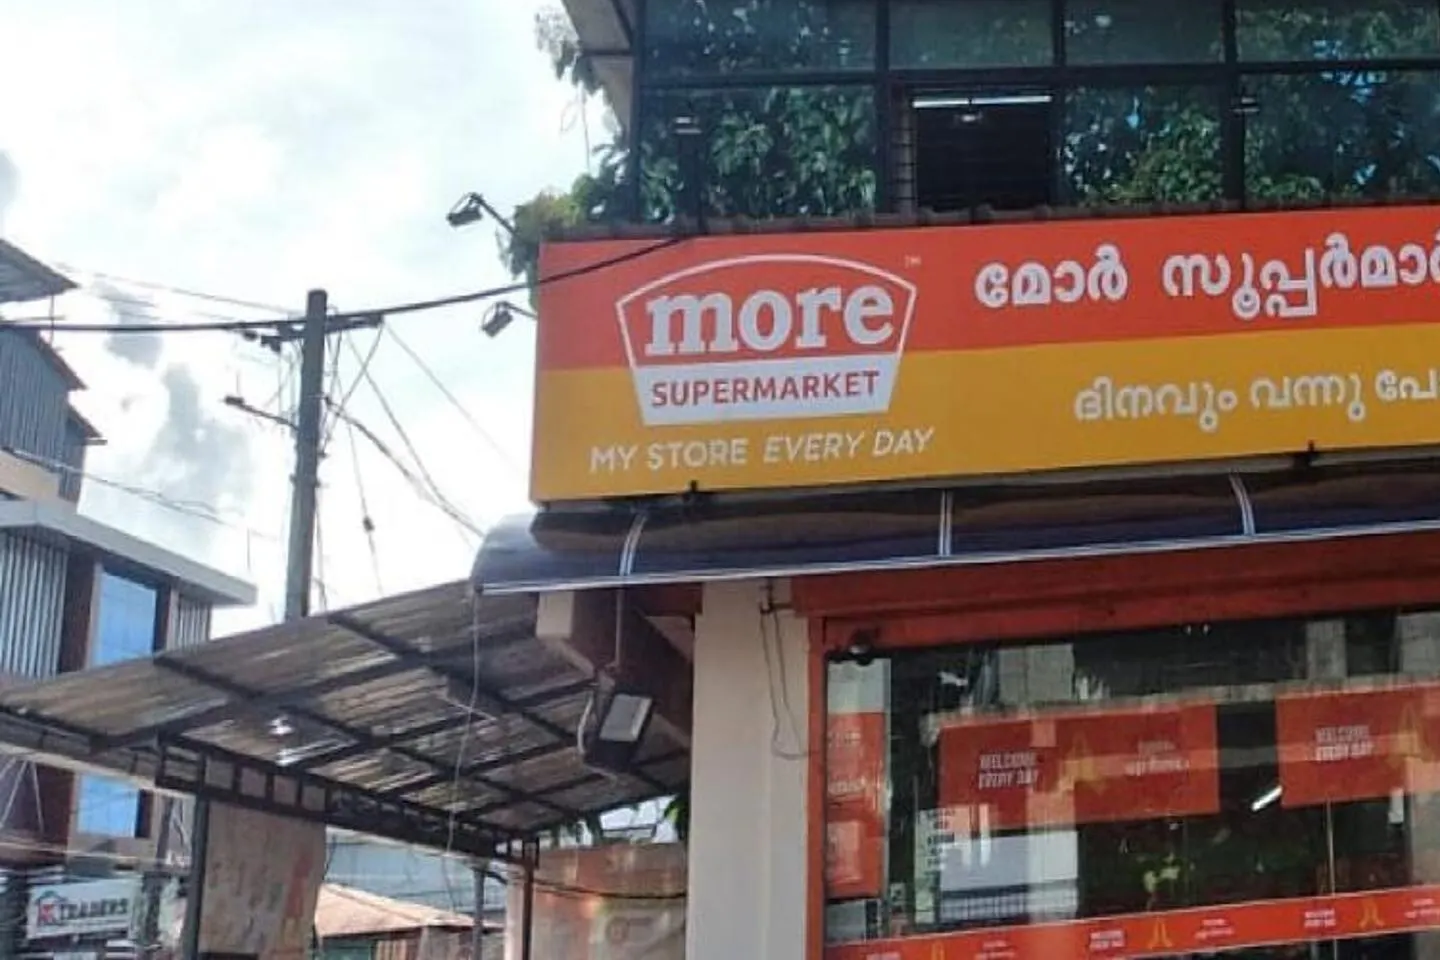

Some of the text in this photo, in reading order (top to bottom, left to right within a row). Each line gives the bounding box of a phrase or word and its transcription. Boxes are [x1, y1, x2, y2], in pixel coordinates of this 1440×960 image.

[974, 243, 1130, 308] മോർ
[645, 284, 894, 357] more
[651, 370, 880, 407] SUPERMARKET
[1075, 376, 1237, 432] ദിനവും
[1249, 372, 1366, 421] വന്നു
[590, 427, 936, 473] MY STORE EVERY DAY
